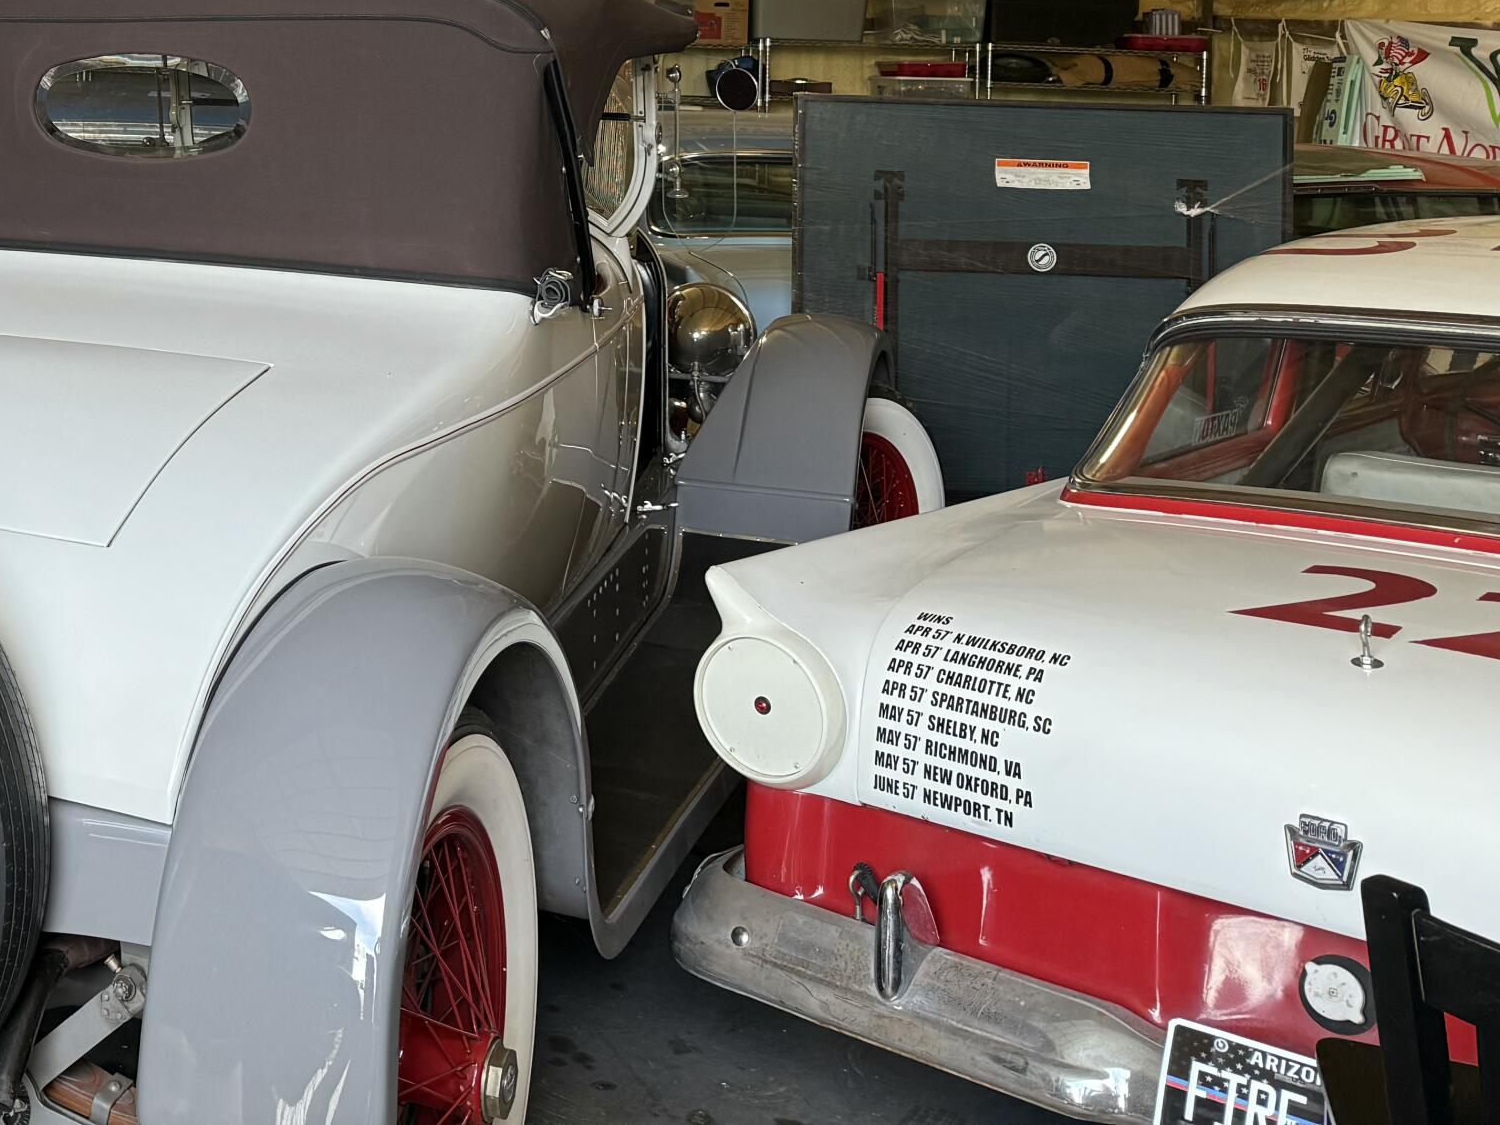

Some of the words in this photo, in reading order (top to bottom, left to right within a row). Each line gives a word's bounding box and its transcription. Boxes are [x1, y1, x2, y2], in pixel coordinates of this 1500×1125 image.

[1257, 77, 1268, 92] 16
[1022, 161, 1069, 169] WARNING
[916, 612, 953, 625] WINS
[895, 638, 920, 655] APR
[943, 649, 1023, 680] LANGHORNE,
[1025, 667, 1045, 683] PA
[904, 624, 933, 638] APR
[953, 633, 1046, 663] N.WILKSBORO,
[1049, 652, 1071, 667] NC
[887, 657, 913, 676] APR
[936, 668, 1012, 701] CHARLOTTE,
[1015, 686, 1036, 705] NC
[878, 702, 904, 724] MAY
[927, 714, 977, 744] SHELBY,
[980, 727, 1000, 748] NC
[881, 679, 907, 699] APR
[930, 690, 1029, 731] SPARTANBURG,
[1033, 715, 1052, 735] SC
[876, 726, 901, 747] MAY
[925, 738, 1000, 776] RICHMOND,
[1004, 759, 1022, 780] VA
[873, 774, 900, 796] JUNE
[922, 787, 992, 822] NEWPORT.
[995, 808, 1014, 828] TN
[874, 750, 900, 771] MAY
[923, 763, 951, 785] NEW
[956, 772, 1012, 804] OXFORD,
[1015, 788, 1033, 808] PA
[1300, 819, 1341, 842] FORD
